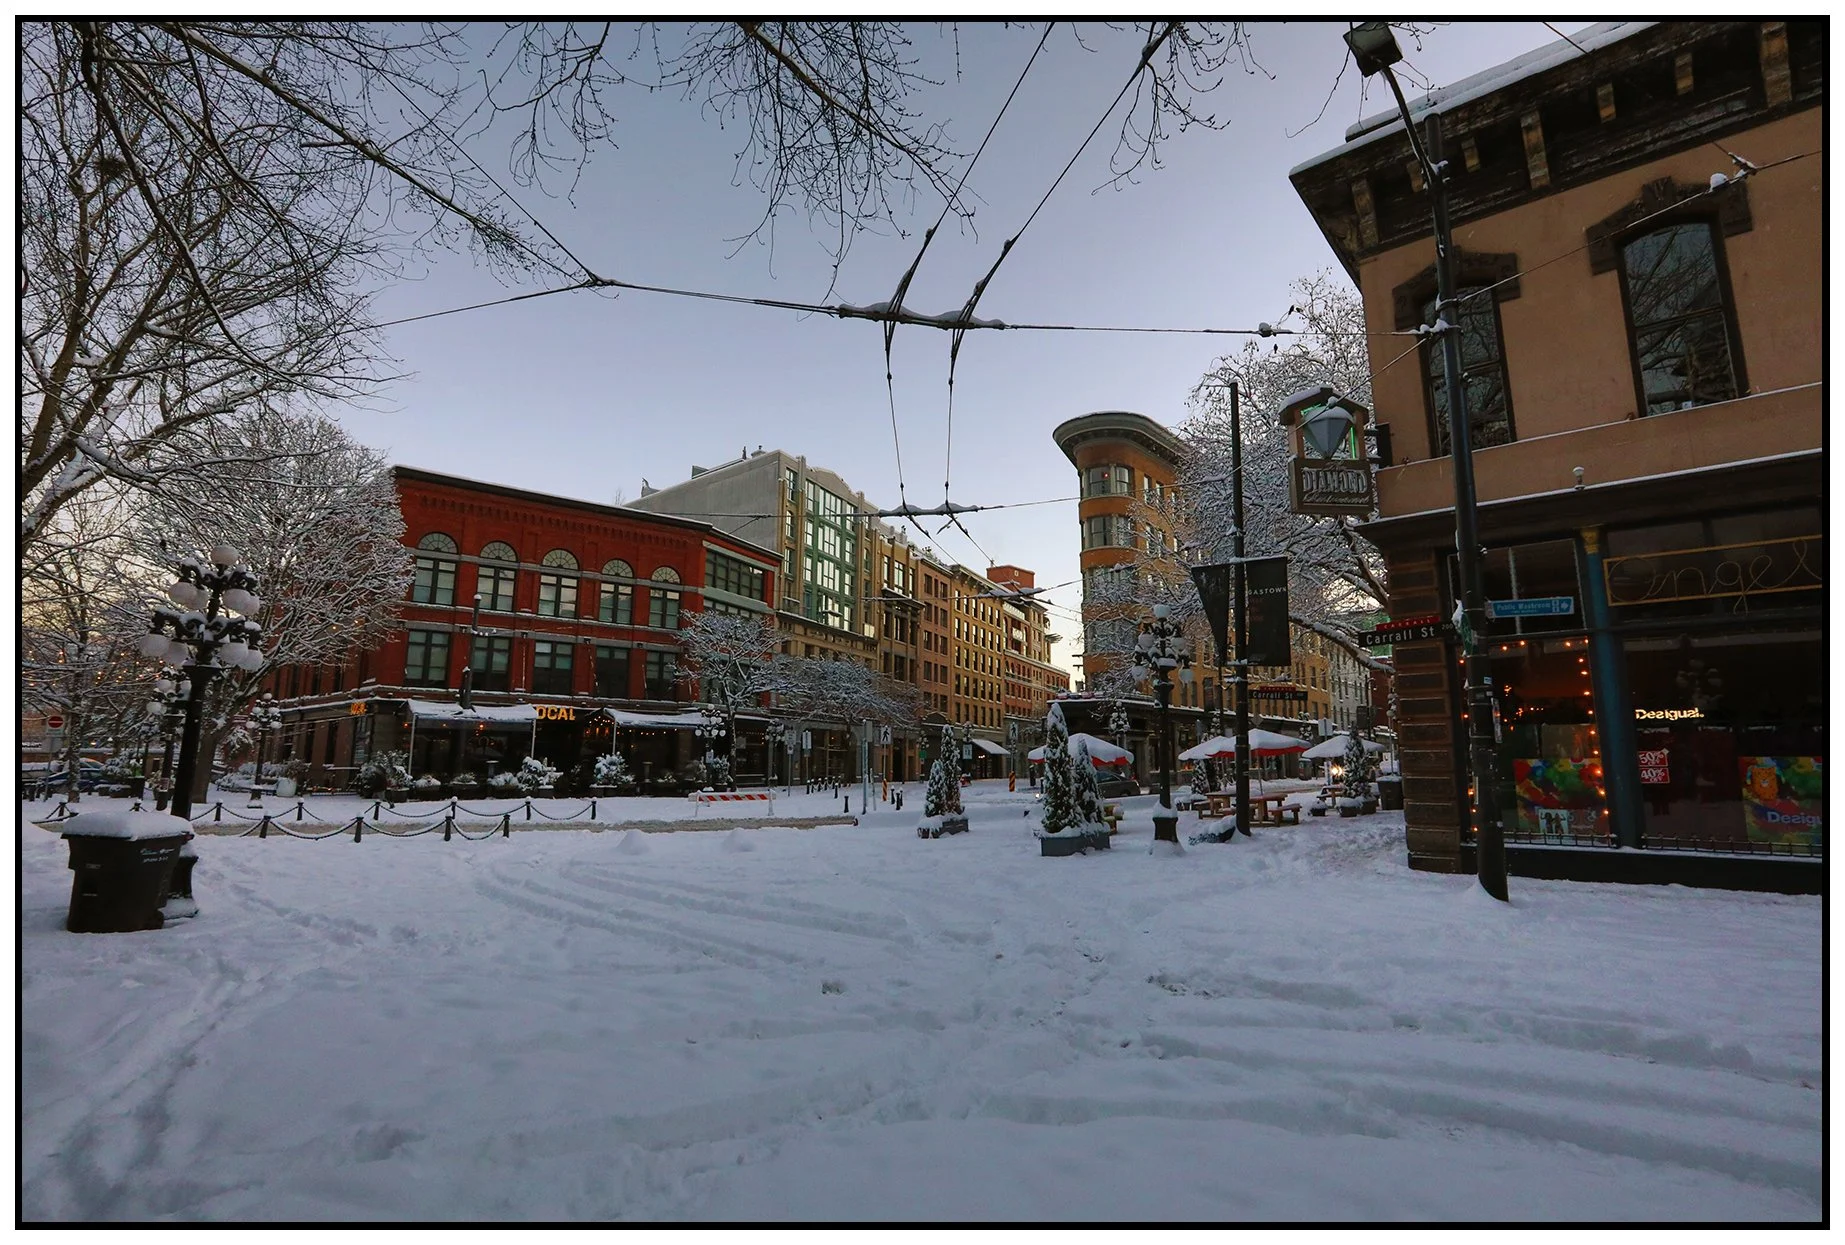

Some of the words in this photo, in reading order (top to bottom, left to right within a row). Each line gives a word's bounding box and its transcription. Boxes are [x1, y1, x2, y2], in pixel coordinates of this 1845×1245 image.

[1302, 467, 1368, 494] DIAMOND
[1366, 630, 1412, 646] Carrall
[1421, 627, 1435, 638] St
[1252, 691, 1281, 699] Carrall
[1284, 691, 1293, 699] St
[536, 705, 576, 721] OCAL
[1639, 751, 1664, 764] 50%
[1641, 767, 1665, 780] 40%
